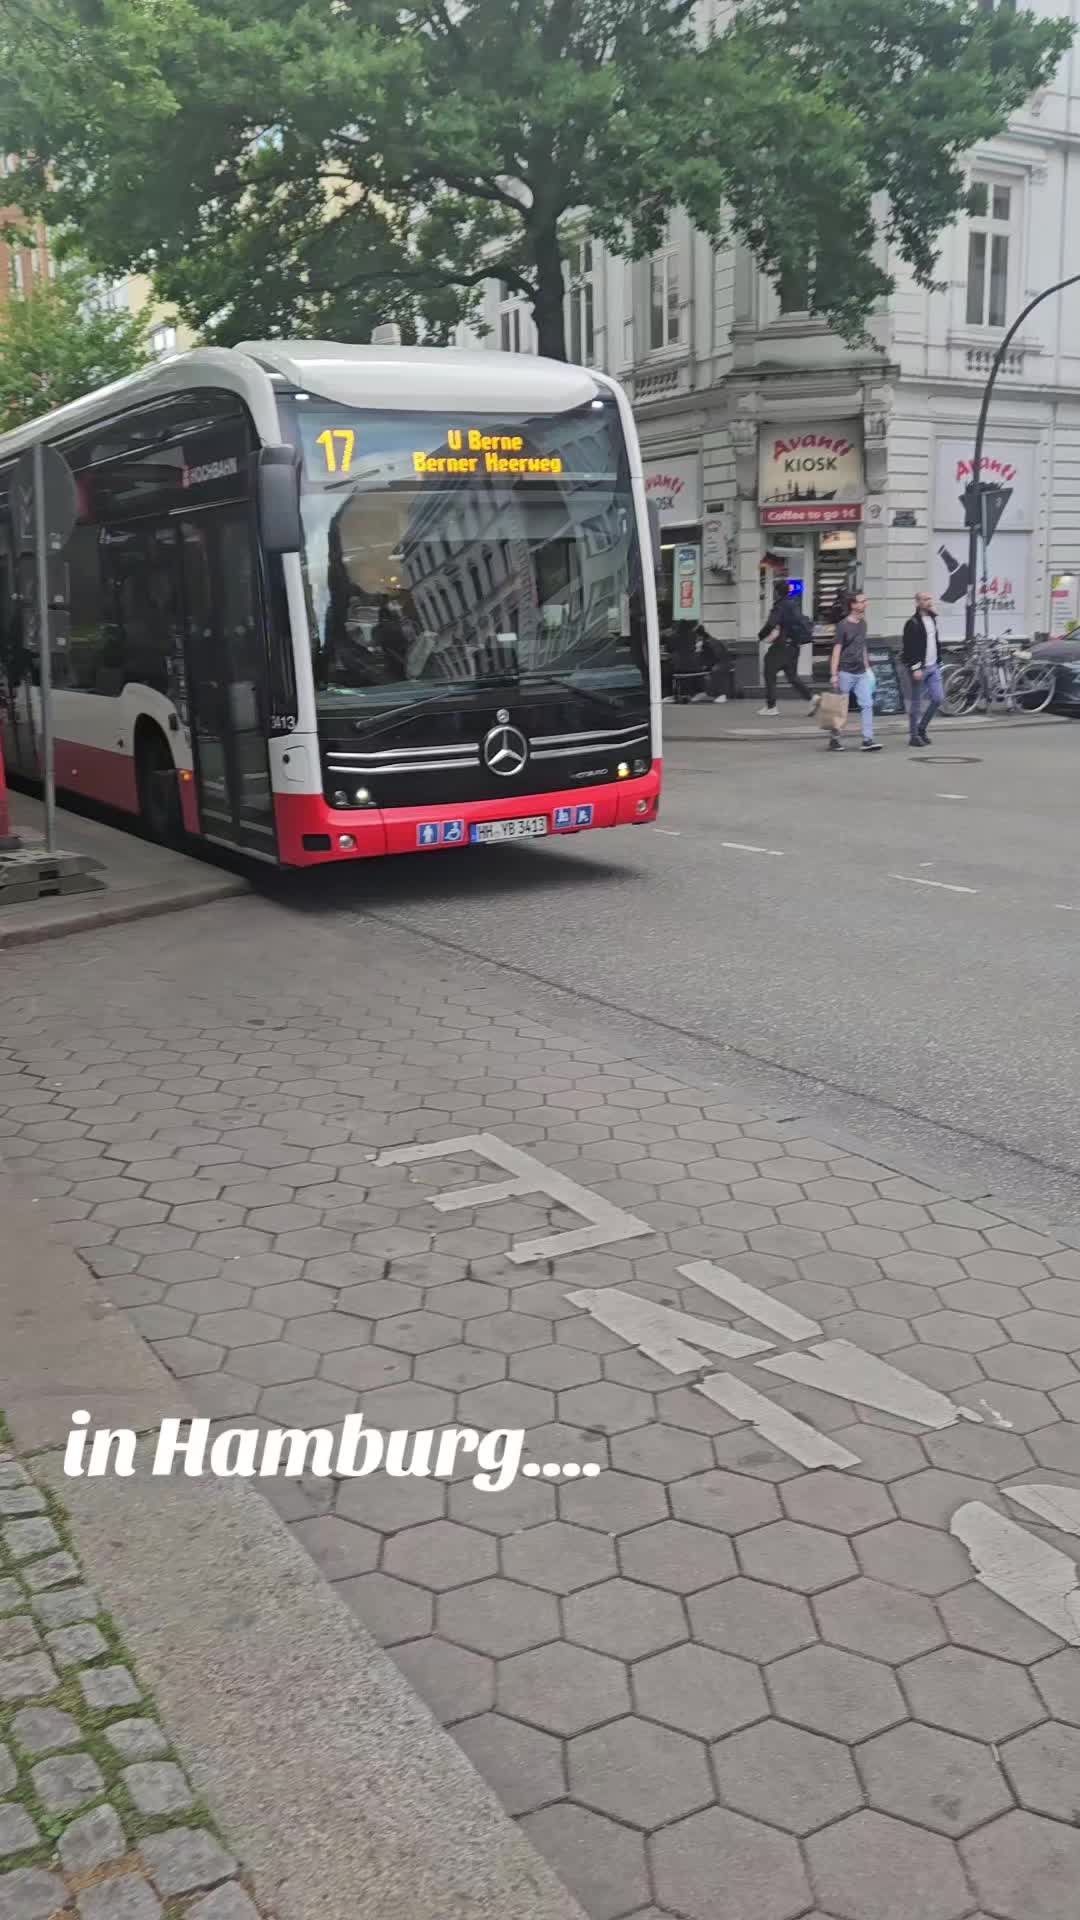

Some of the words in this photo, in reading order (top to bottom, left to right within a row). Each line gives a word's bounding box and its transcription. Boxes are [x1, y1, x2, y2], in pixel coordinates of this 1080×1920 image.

[316, 429, 355, 473] 17
[447, 429, 462, 451] U
[468, 429, 524, 451] Berne
[774, 433, 855, 462] Avanti
[413, 451, 478, 473] Berner
[485, 452, 562, 474] Heerweg
[784, 457, 838, 473] KIOSK
[767, 510, 805, 521] Coffee
[807, 511, 821, 520] to
[823, 510, 839, 521] go
[478, 824, 493, 839] HH
[502, 822, 515, 836] YB
[518, 817, 545, 834] 3413
